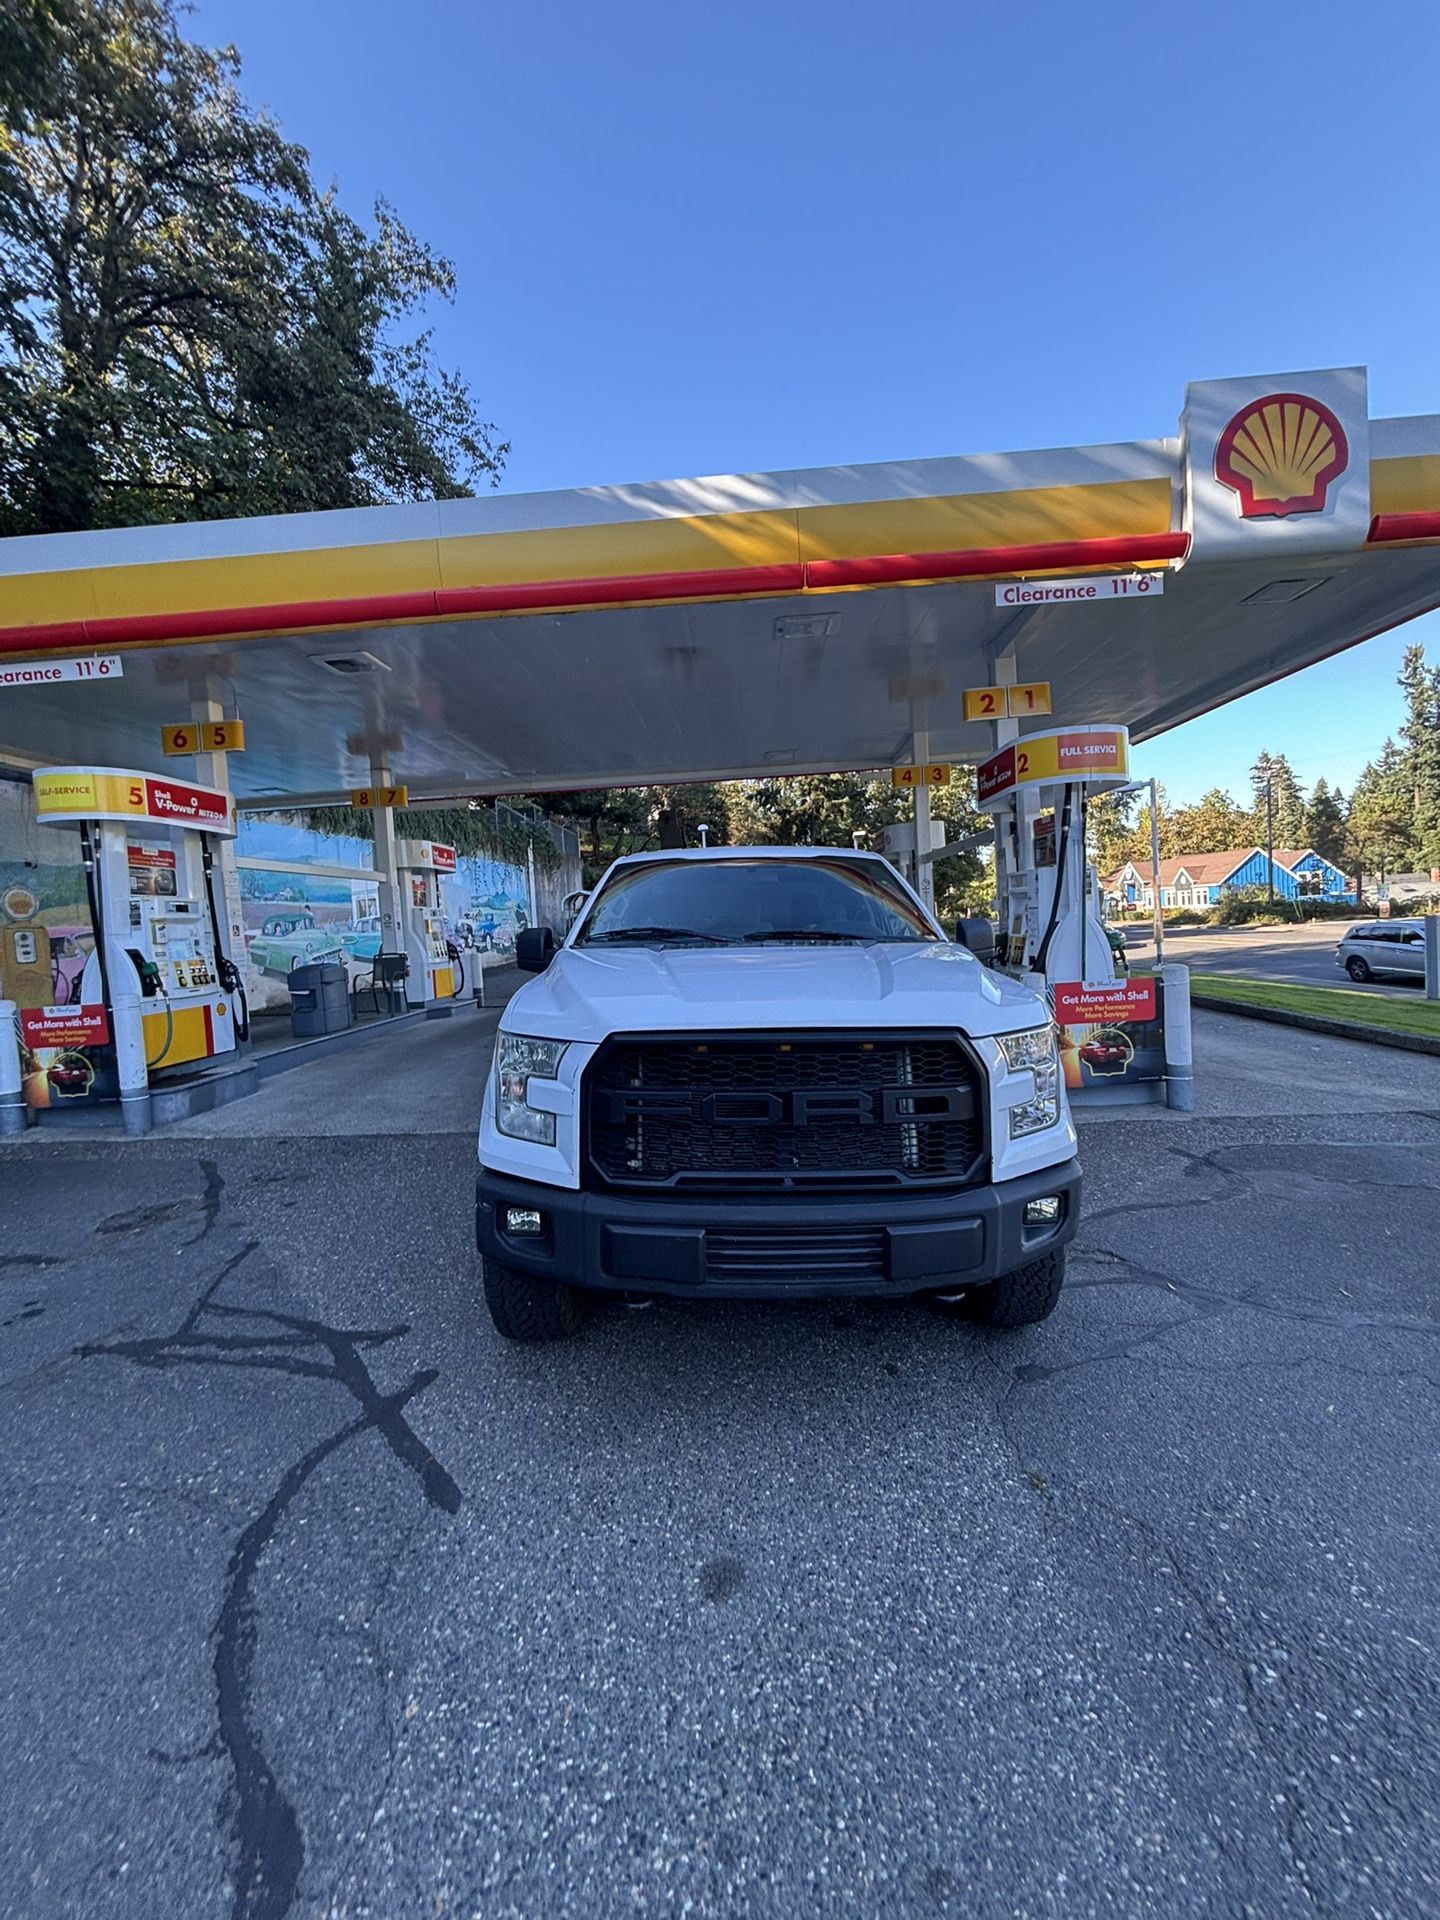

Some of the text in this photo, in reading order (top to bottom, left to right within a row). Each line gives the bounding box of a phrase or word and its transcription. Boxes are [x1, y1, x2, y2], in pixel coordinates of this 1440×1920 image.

[1004, 584, 1096, 603] Clearance
[0, 668, 62, 683] arance
[979, 690, 1034, 713] 2 1
[173, 727, 226, 748] 6 5
[1060, 744, 1117, 757] FULL SERVICE
[1017, 753, 1029, 774] 2
[901, 768, 943, 783] 4 3
[128, 787, 144, 805] 5
[154, 789, 171, 799] Shell
[359, 790, 397, 806] 8 7
[155, 797, 196, 815] V-Power
[1062, 990, 1149, 1005] Get More with Shell
[1094, 1003, 1136, 1011] Performance
[1104, 1010, 1129, 1018] Savings
[28, 1016, 102, 1030] Get More with Shell
[603, 1086, 974, 1126] FORD
